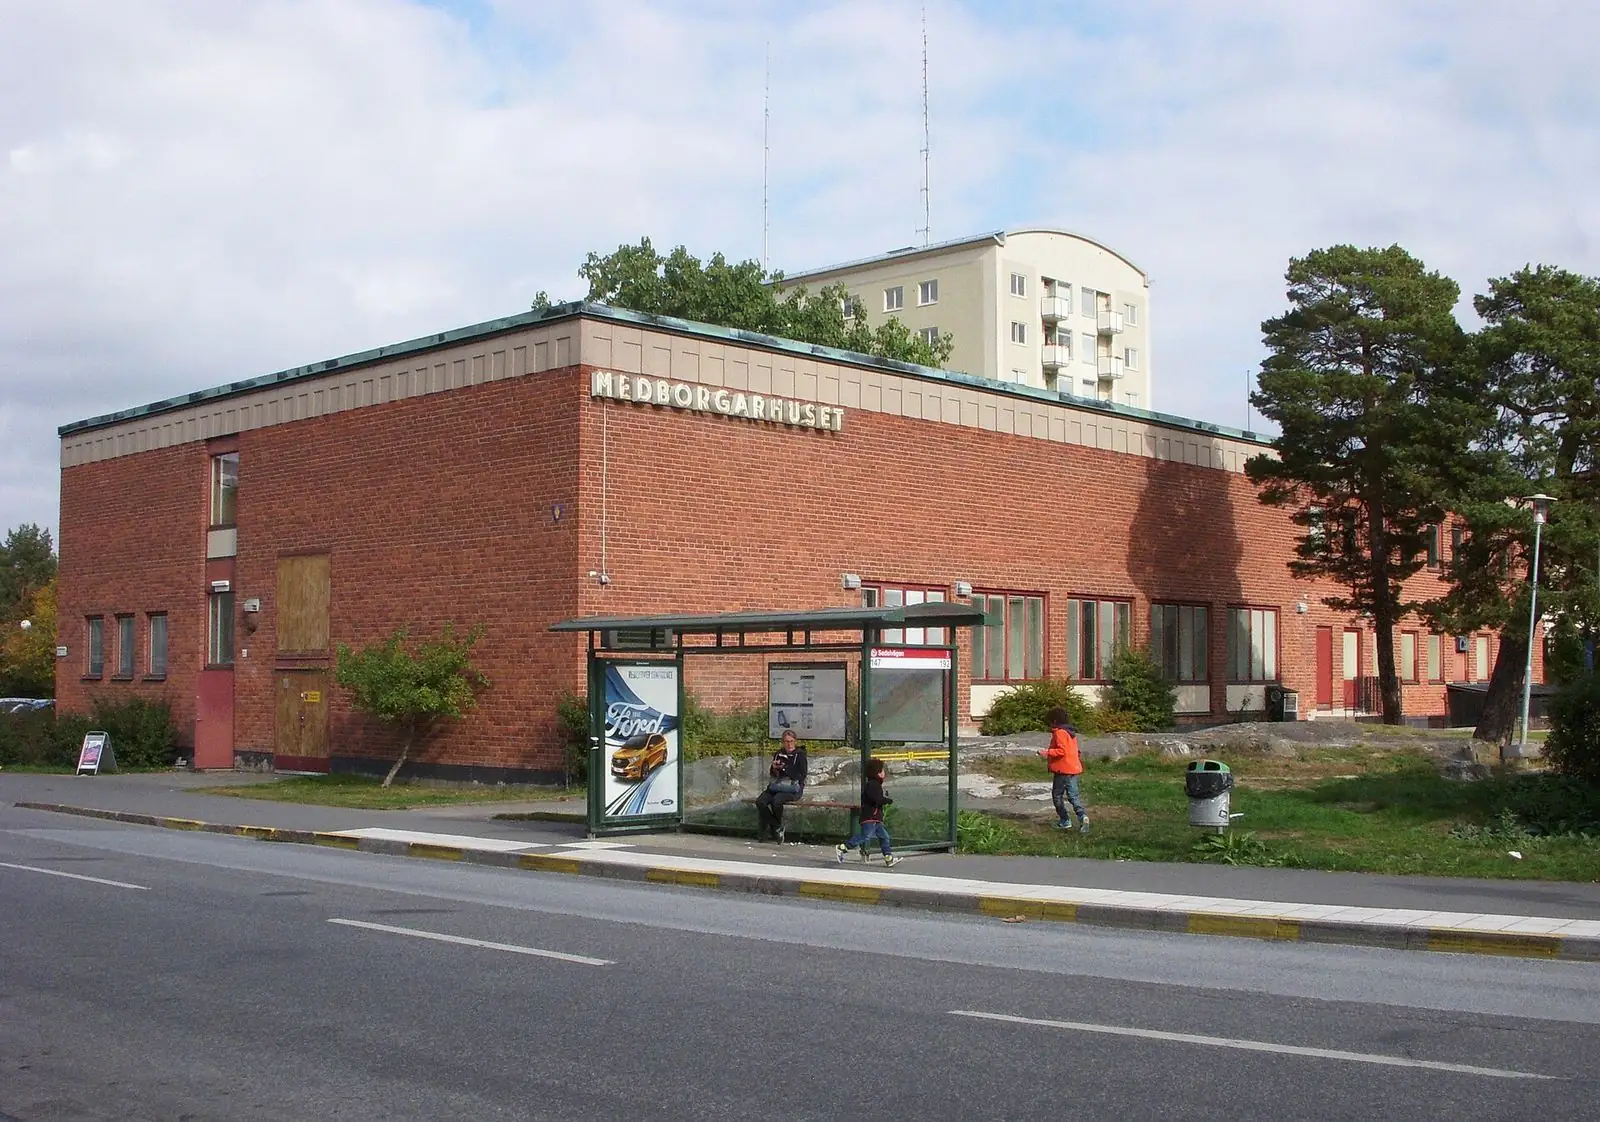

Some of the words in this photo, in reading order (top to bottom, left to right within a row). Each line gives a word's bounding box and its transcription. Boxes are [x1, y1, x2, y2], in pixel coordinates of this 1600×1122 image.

[592, 371, 844, 431] MEDBORGARHUSET
[871, 659, 881, 668] 147
[606, 701, 664, 737] Ford
